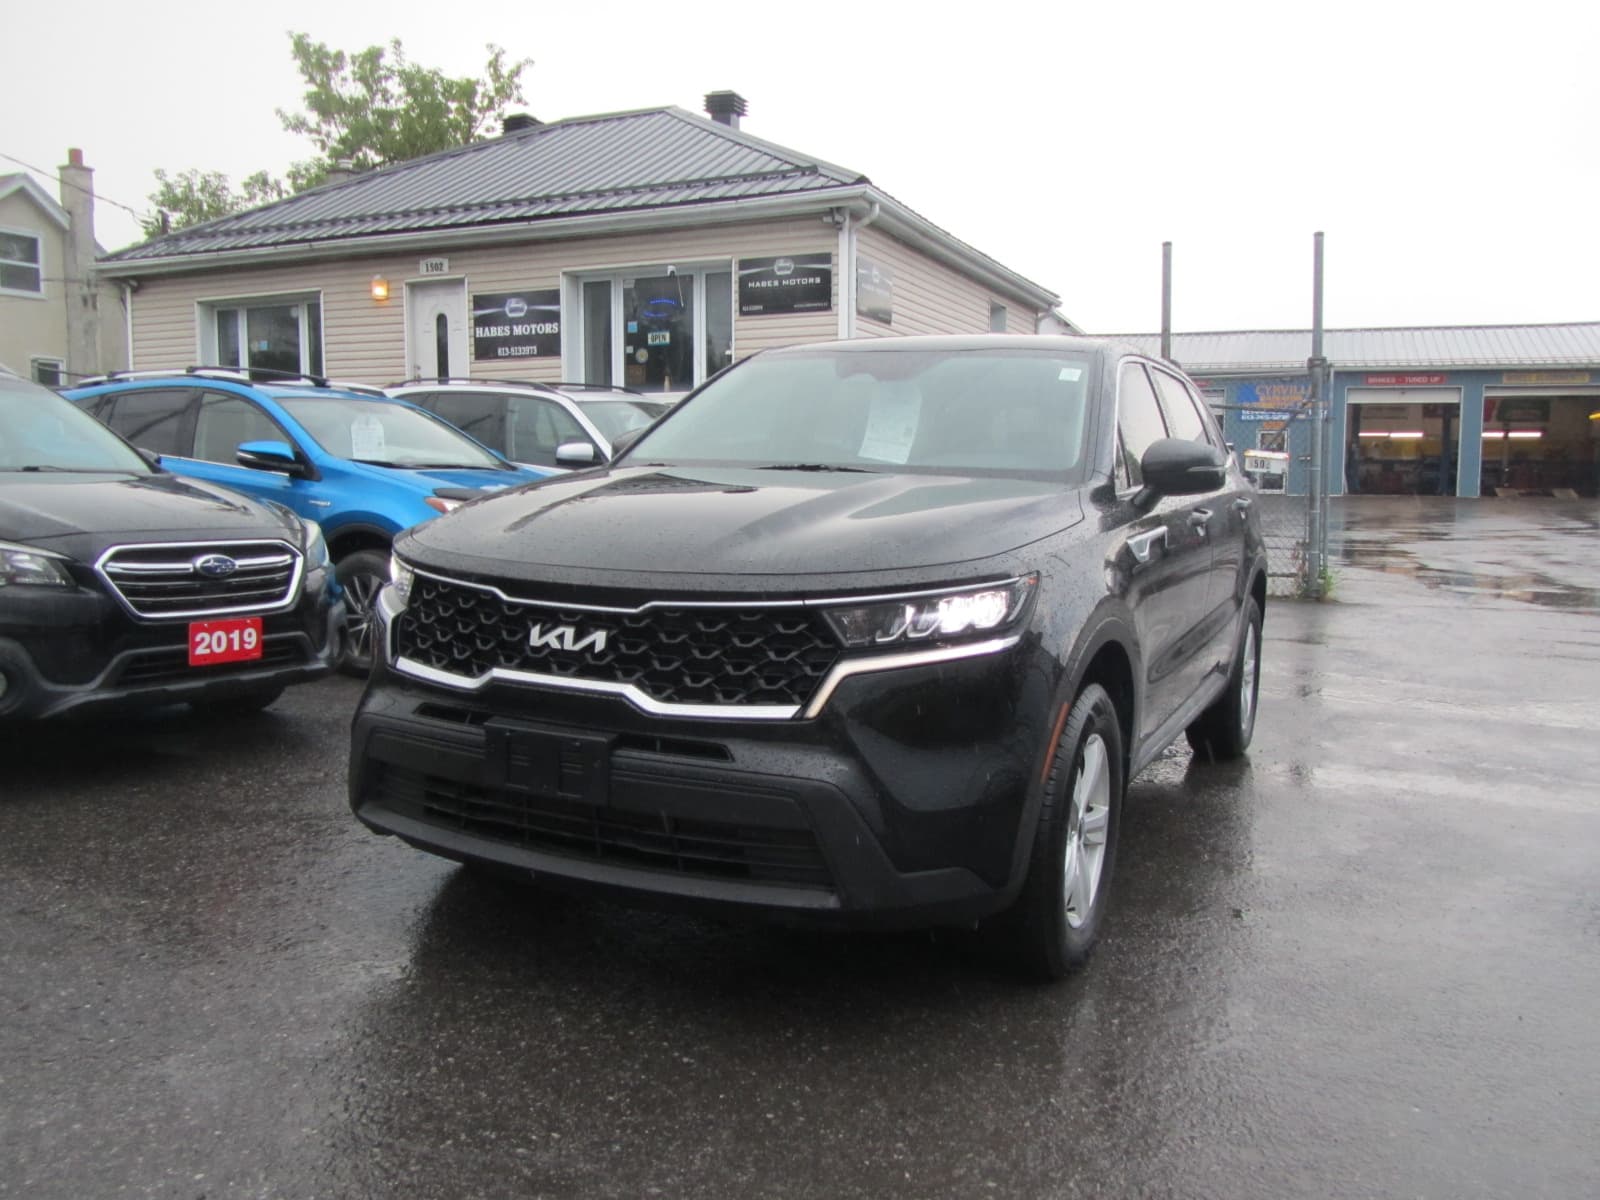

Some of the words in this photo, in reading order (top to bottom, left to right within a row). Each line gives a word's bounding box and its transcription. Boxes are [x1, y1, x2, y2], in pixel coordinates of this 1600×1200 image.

[748, 280, 779, 289] HABES
[782, 277, 821, 286] MOTORS
[475, 325, 511, 338] HABES
[512, 322, 559, 336] MOTORS
[650, 334, 667, 343] OPEN
[194, 627, 257, 656] 2019
[529, 623, 607, 654] KIA
